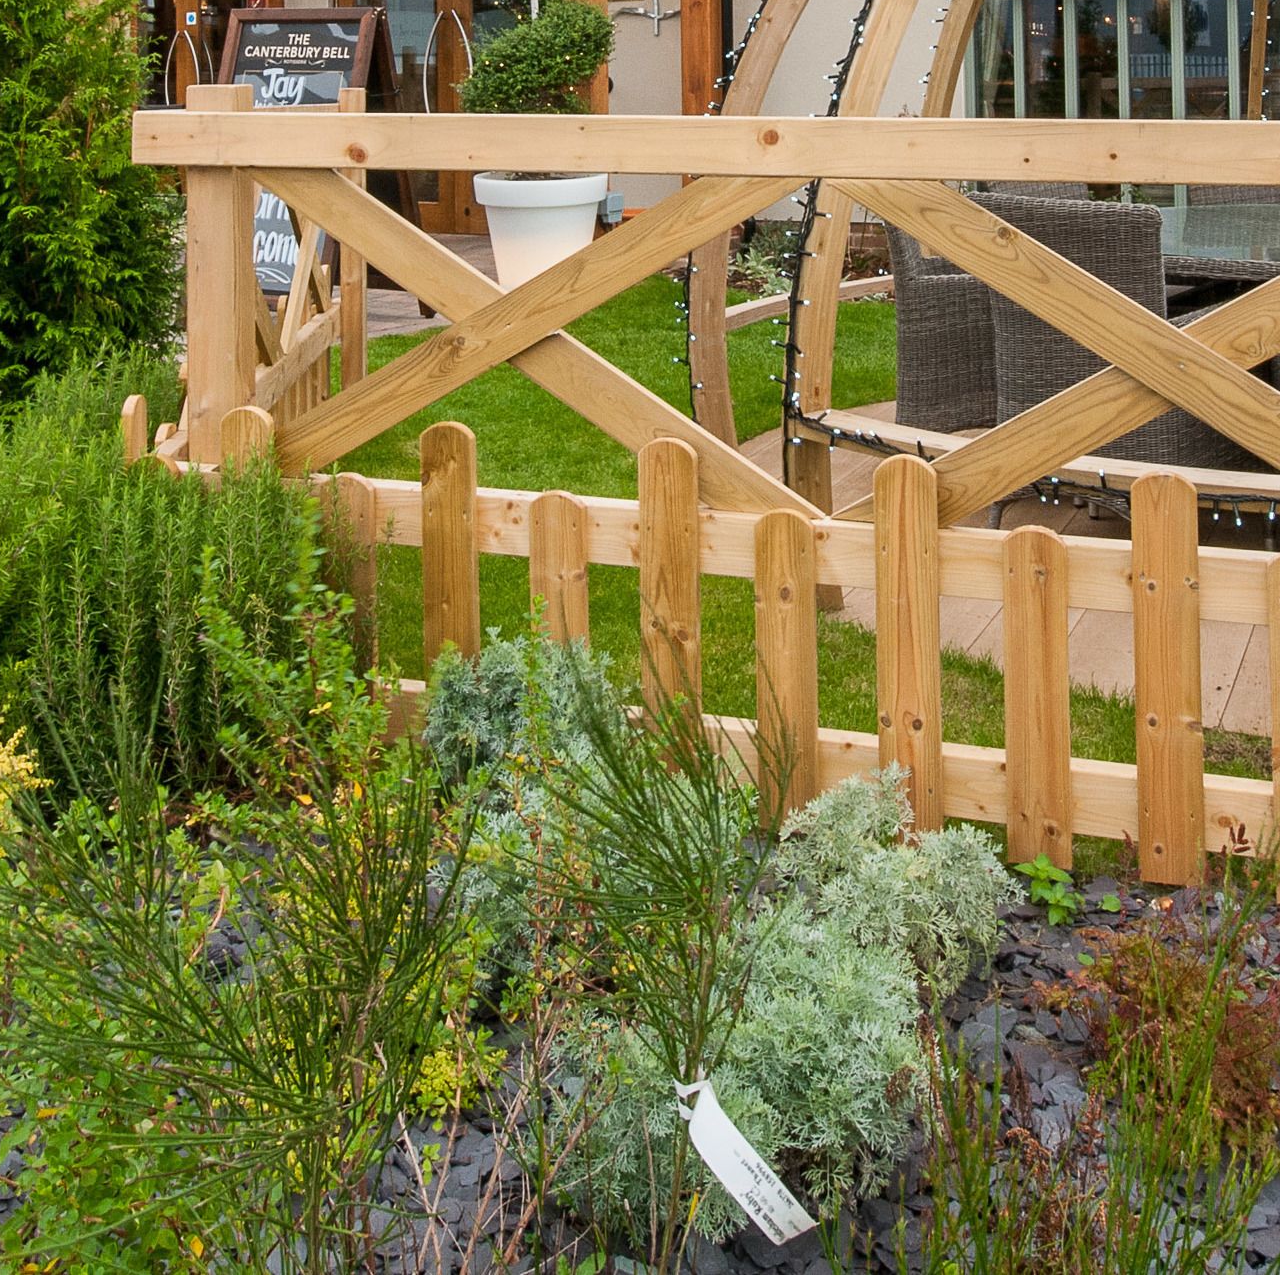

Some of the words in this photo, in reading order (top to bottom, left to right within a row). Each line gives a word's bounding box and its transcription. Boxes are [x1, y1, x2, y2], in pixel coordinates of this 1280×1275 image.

[287, 33, 312, 46] THE
[244, 45, 322, 59] CANTERBURY
[322, 46, 351, 59] BELL
